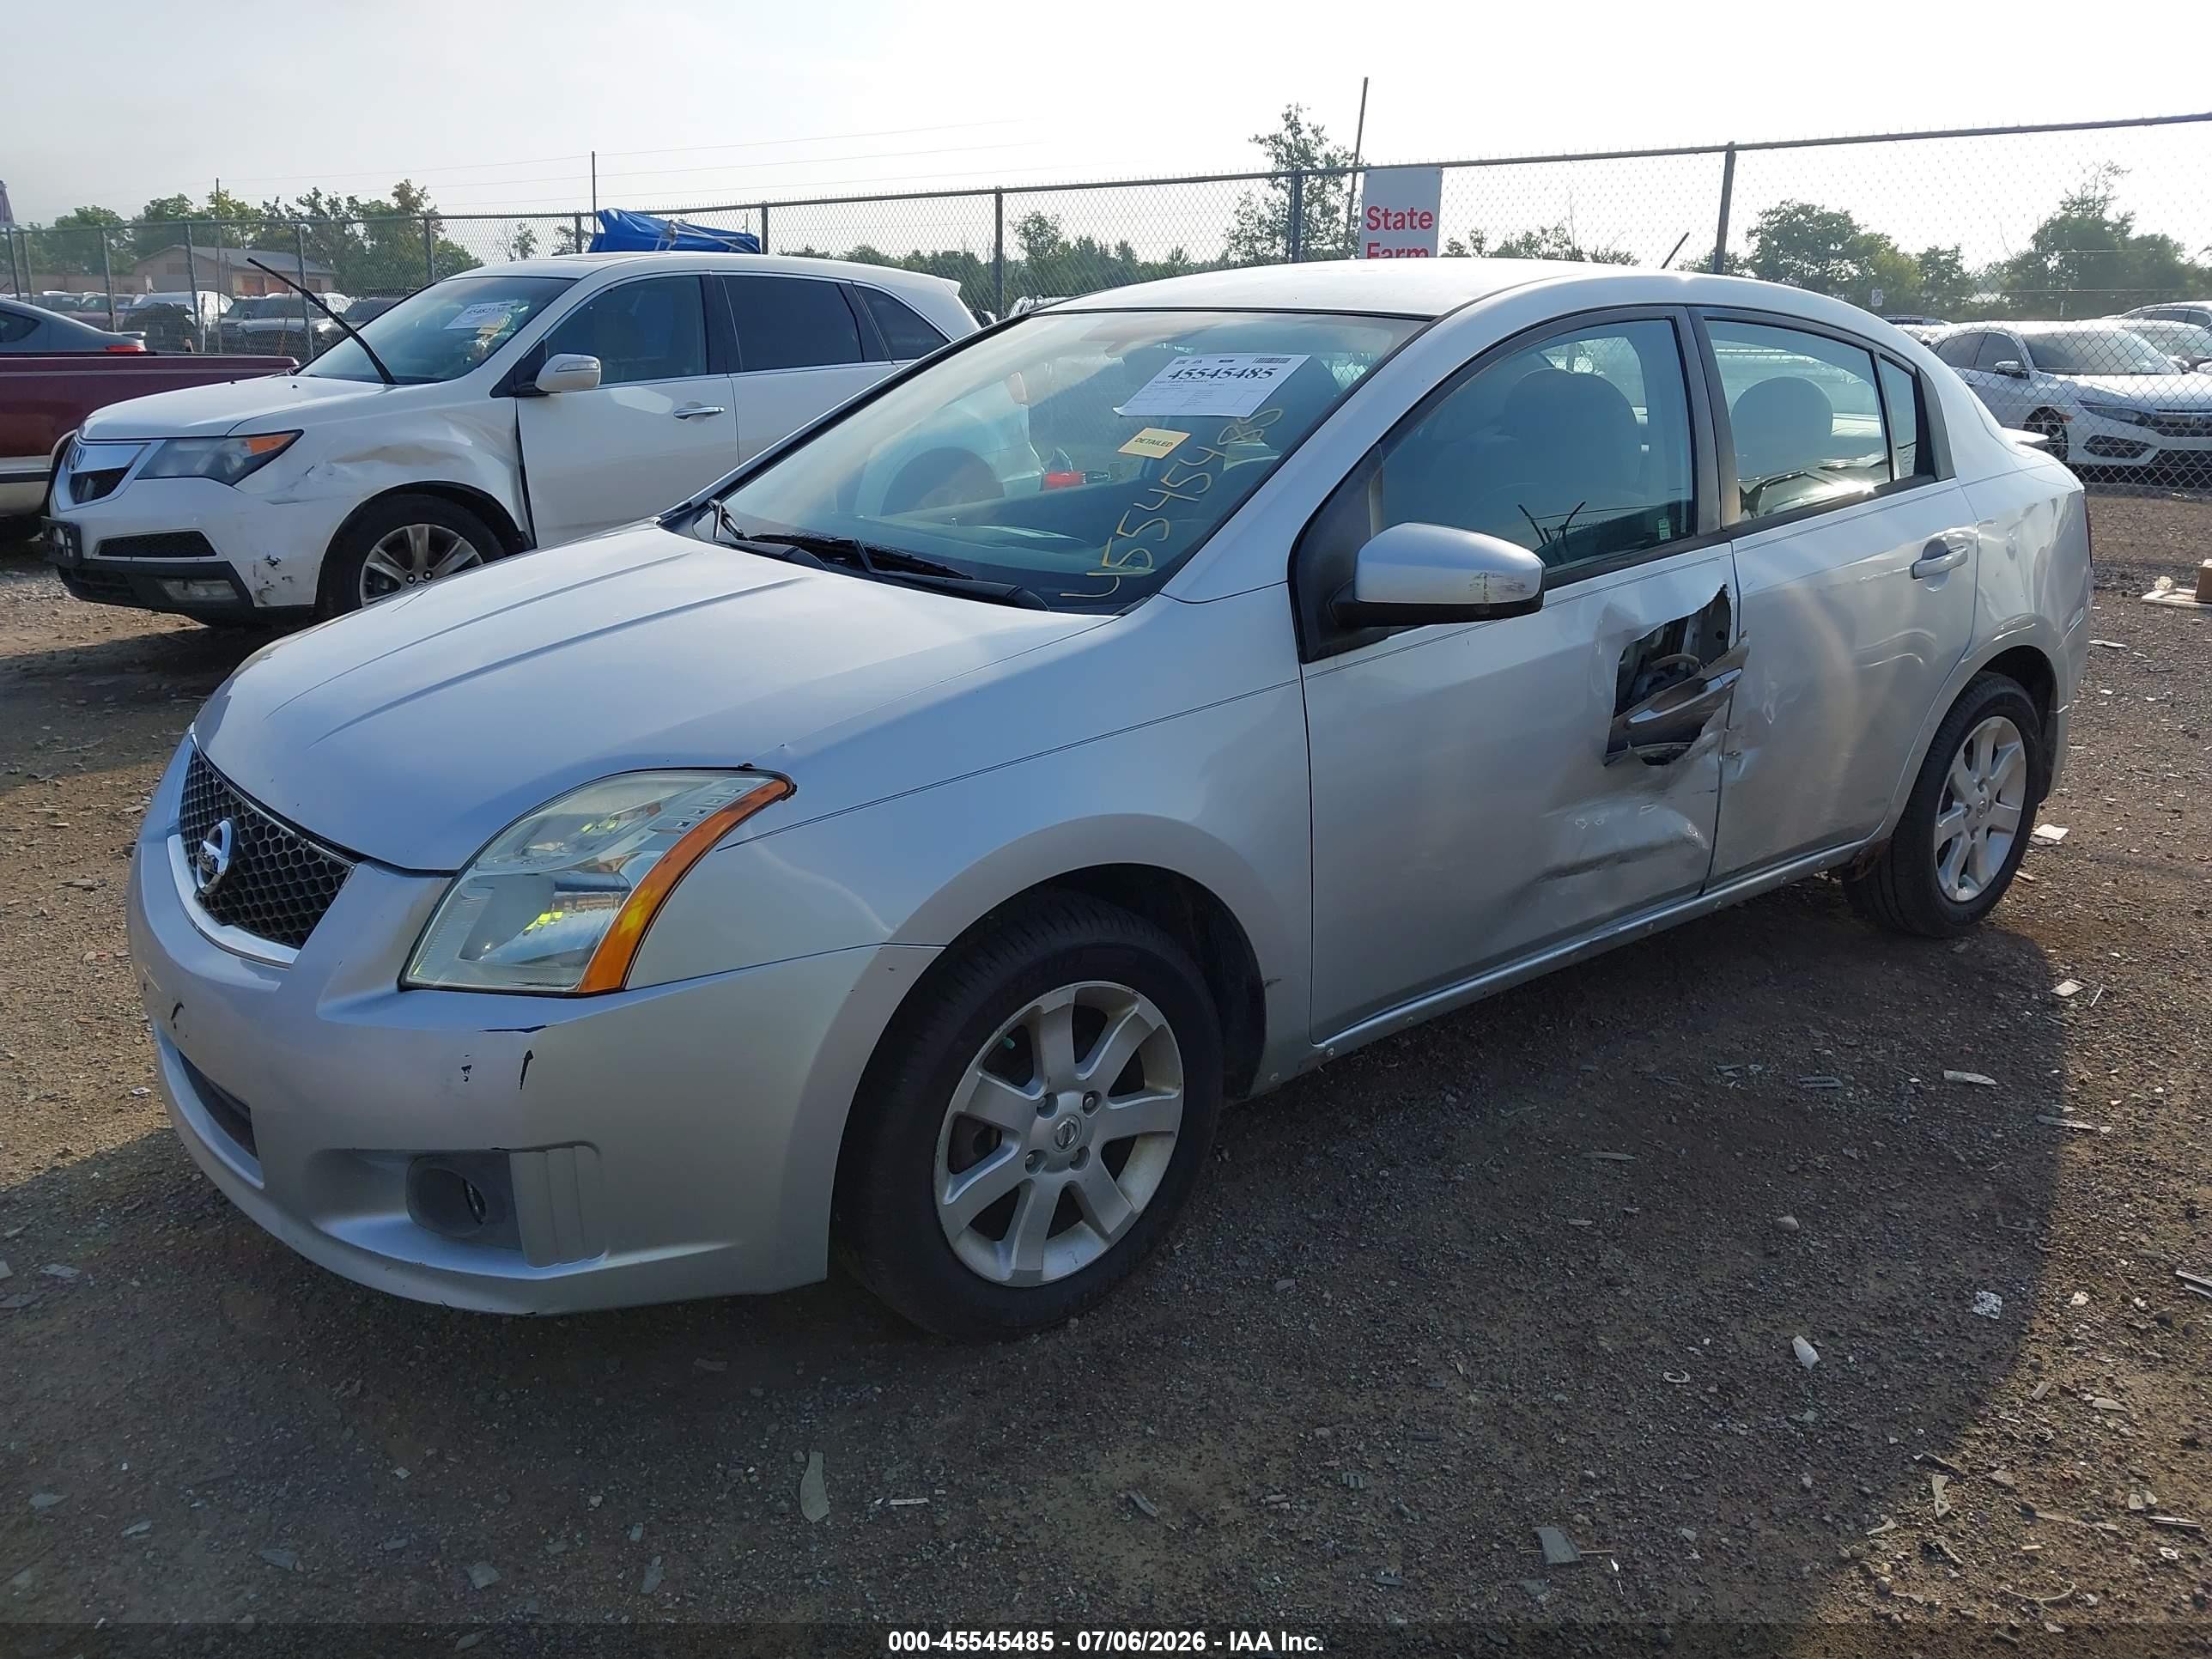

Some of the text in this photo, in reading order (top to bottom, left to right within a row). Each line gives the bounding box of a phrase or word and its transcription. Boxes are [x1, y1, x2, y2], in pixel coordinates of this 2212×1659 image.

[1365, 205, 1433, 231] State
[1366, 242, 1429, 258] Farm
[1168, 367, 1279, 380] 45545485
[1133, 437, 1175, 448] DETAILED
